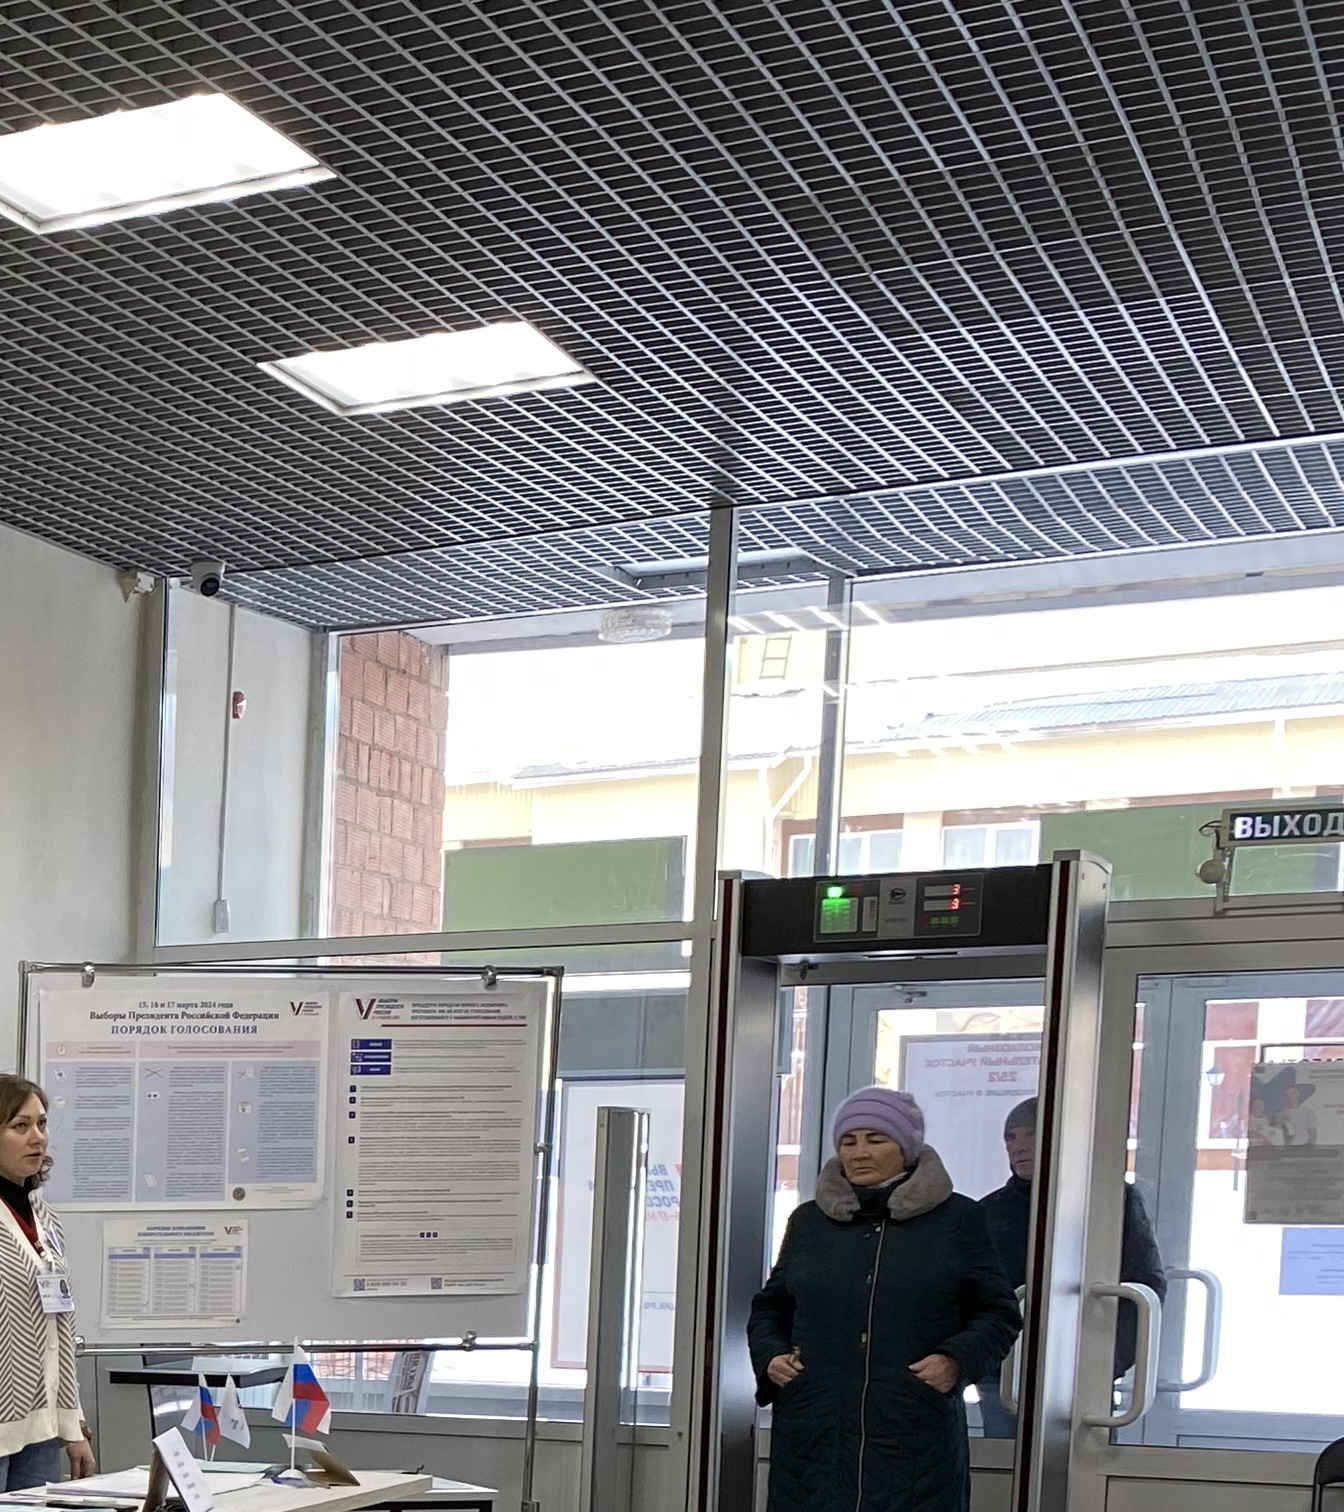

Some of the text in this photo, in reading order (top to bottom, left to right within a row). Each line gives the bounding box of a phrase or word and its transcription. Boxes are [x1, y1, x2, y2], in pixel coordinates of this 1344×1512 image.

[1234, 812, 1344, 839] ВЫХОД
[89, 1011, 279, 1021] Выборы Президента Российской Федерации
[111, 1025, 258, 1035] ПОРЯДОК ГОЛОСОВАНИЯ
